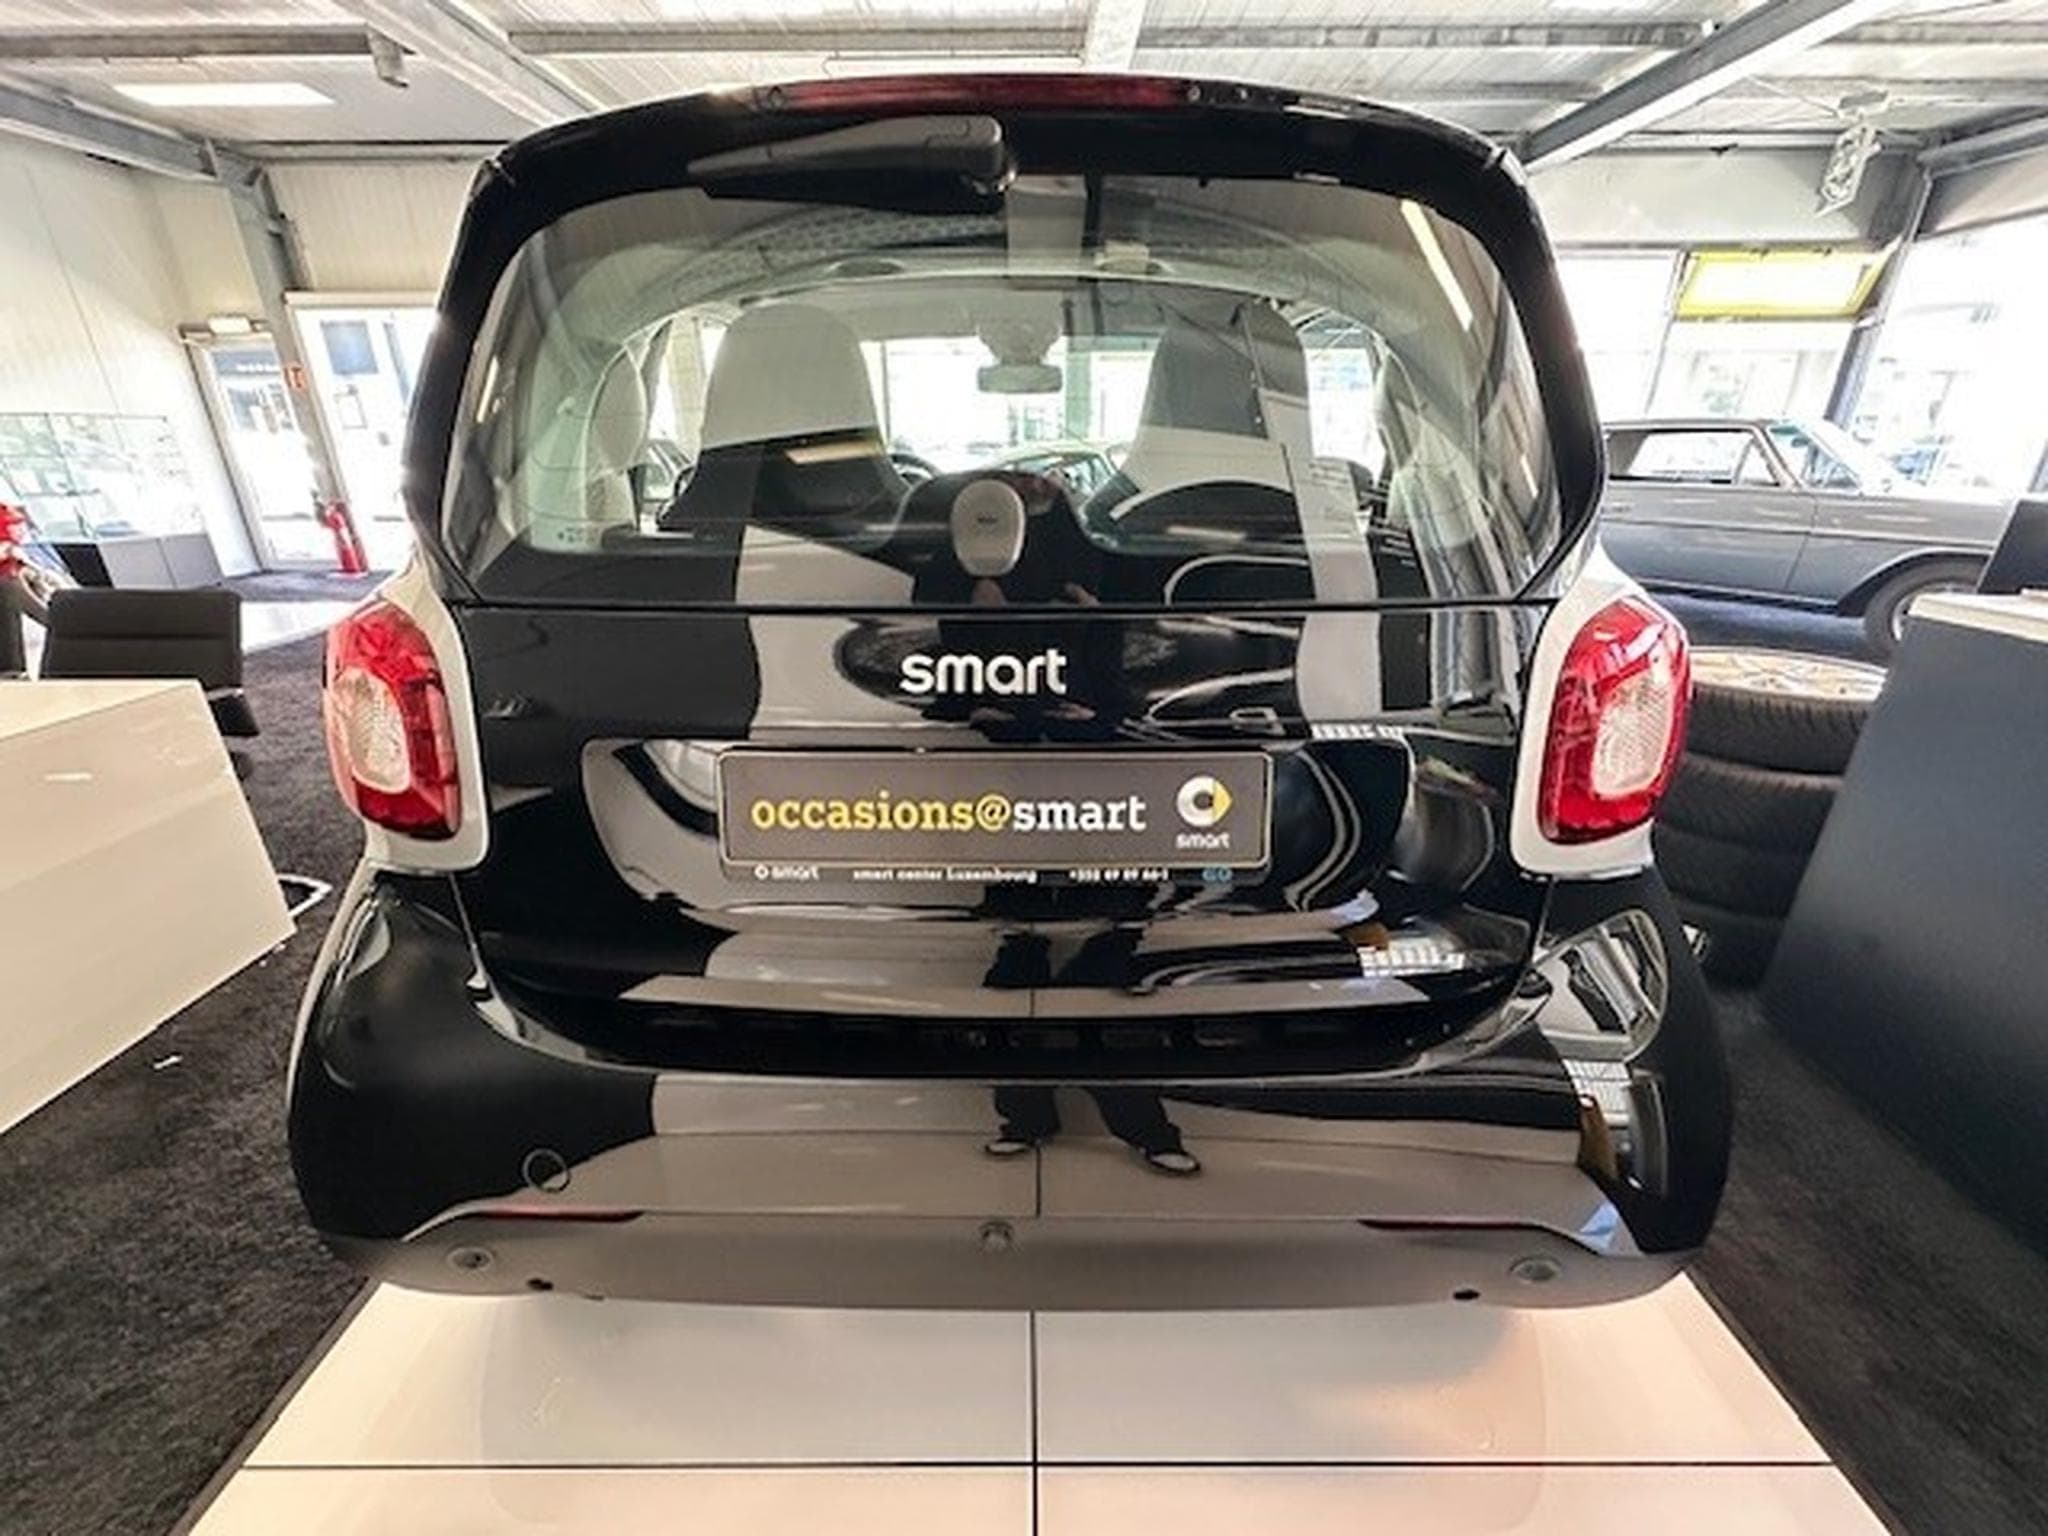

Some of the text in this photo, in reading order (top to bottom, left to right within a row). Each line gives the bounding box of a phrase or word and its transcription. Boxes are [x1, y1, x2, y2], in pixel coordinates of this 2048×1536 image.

[900, 648, 1067, 695] smart
[751, 789, 1147, 833] occasions@smart
[1175, 832, 1231, 850] smart
[771, 866, 819, 881] smart
